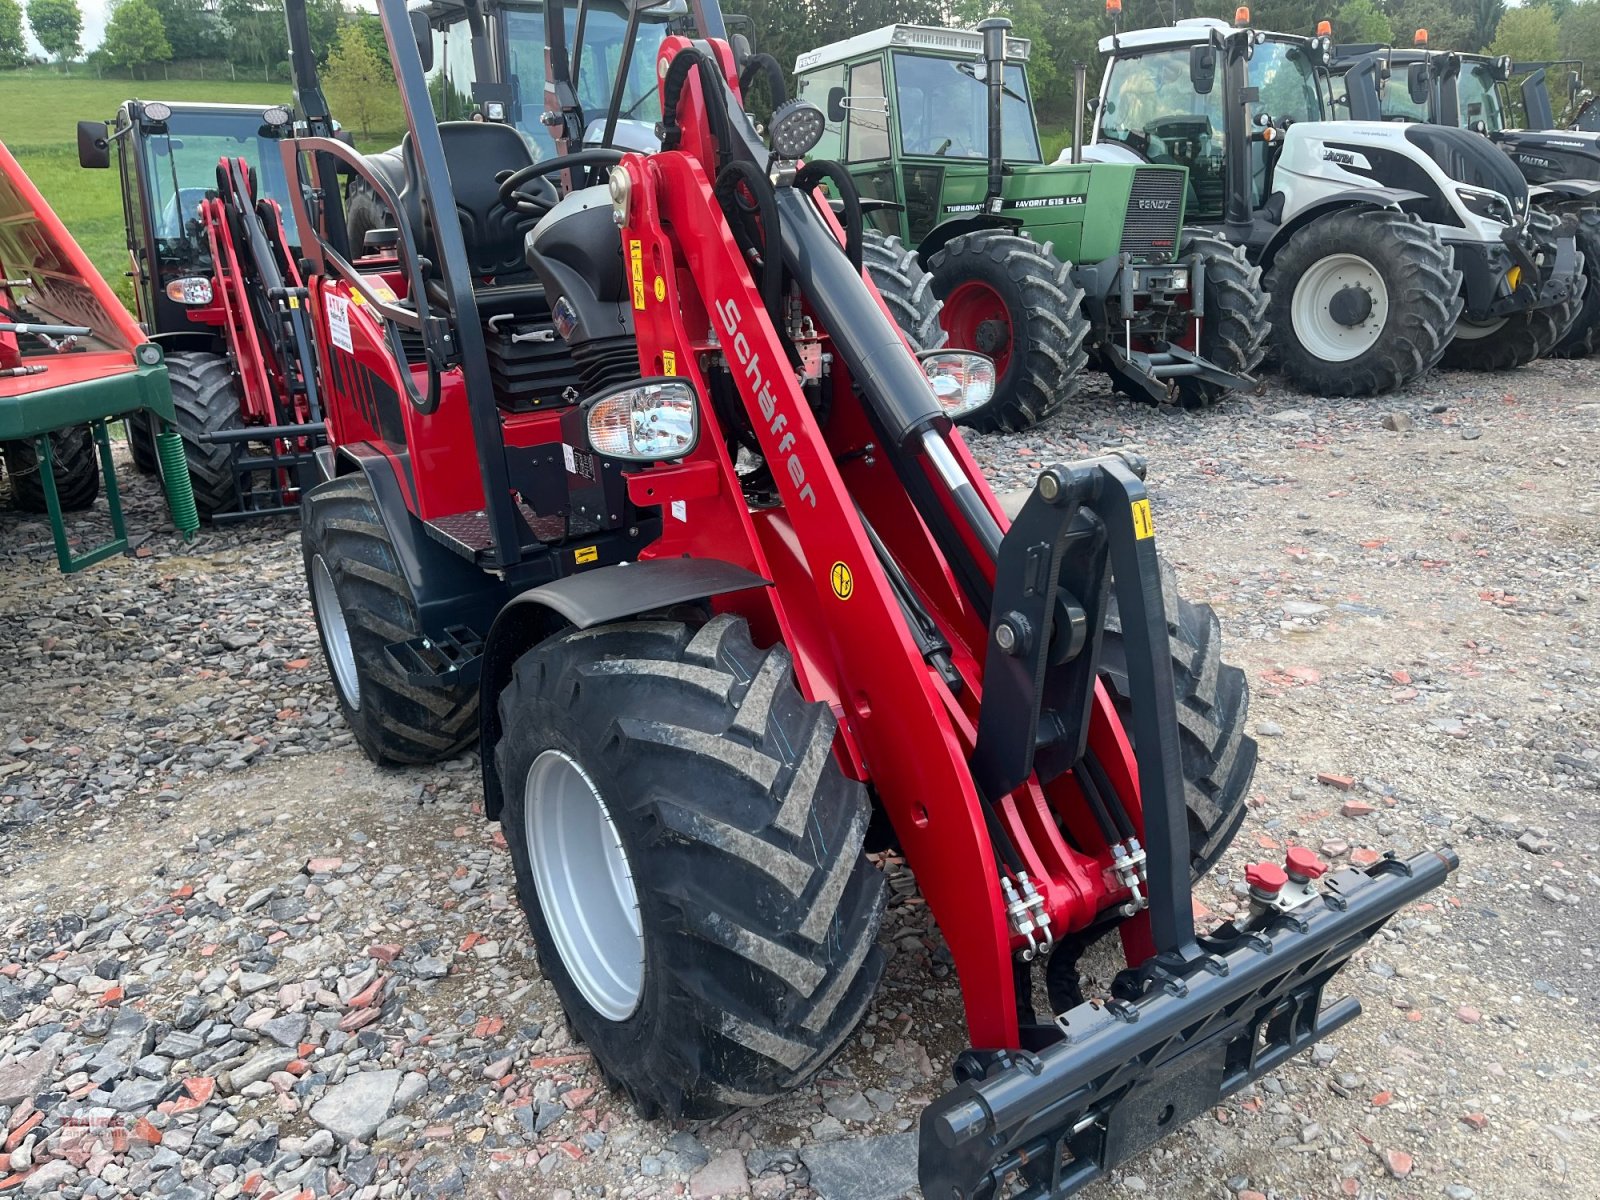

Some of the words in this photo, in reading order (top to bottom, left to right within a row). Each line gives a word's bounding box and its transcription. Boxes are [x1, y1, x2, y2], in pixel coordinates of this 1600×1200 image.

[1520, 154, 1549, 167] VALTRA
[1015, 199, 1047, 208] FAVORIT
[1066, 196, 1082, 205] LSA
[1139, 200, 1171, 209] FENDT
[715, 298, 816, 508] Schäffer
